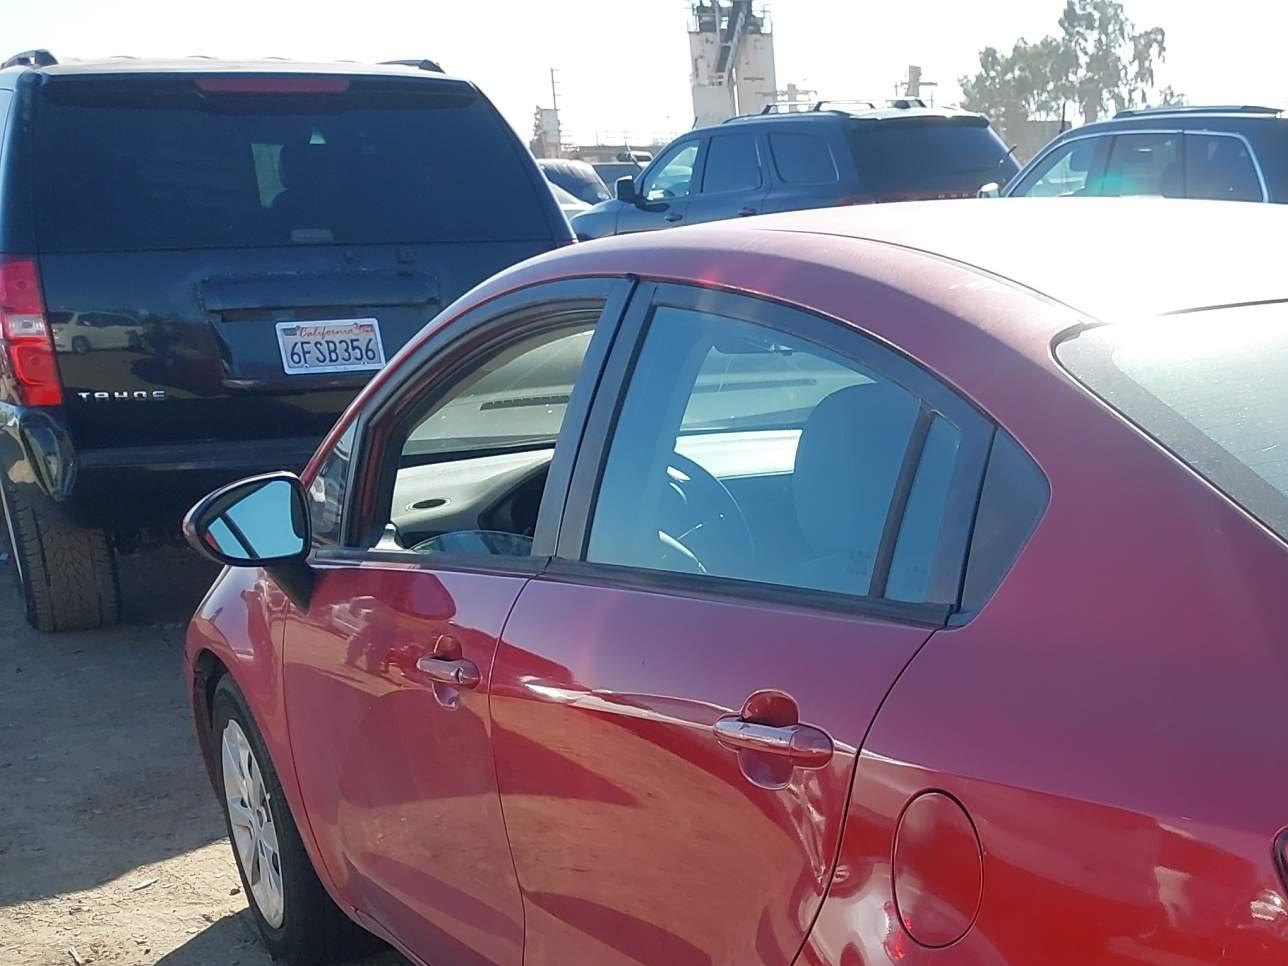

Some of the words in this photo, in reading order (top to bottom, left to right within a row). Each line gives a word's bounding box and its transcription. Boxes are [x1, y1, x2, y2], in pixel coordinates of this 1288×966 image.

[300, 326, 354, 339] California
[290, 338, 376, 364] 6FSB356
[77, 390, 166, 400] TAHOE
